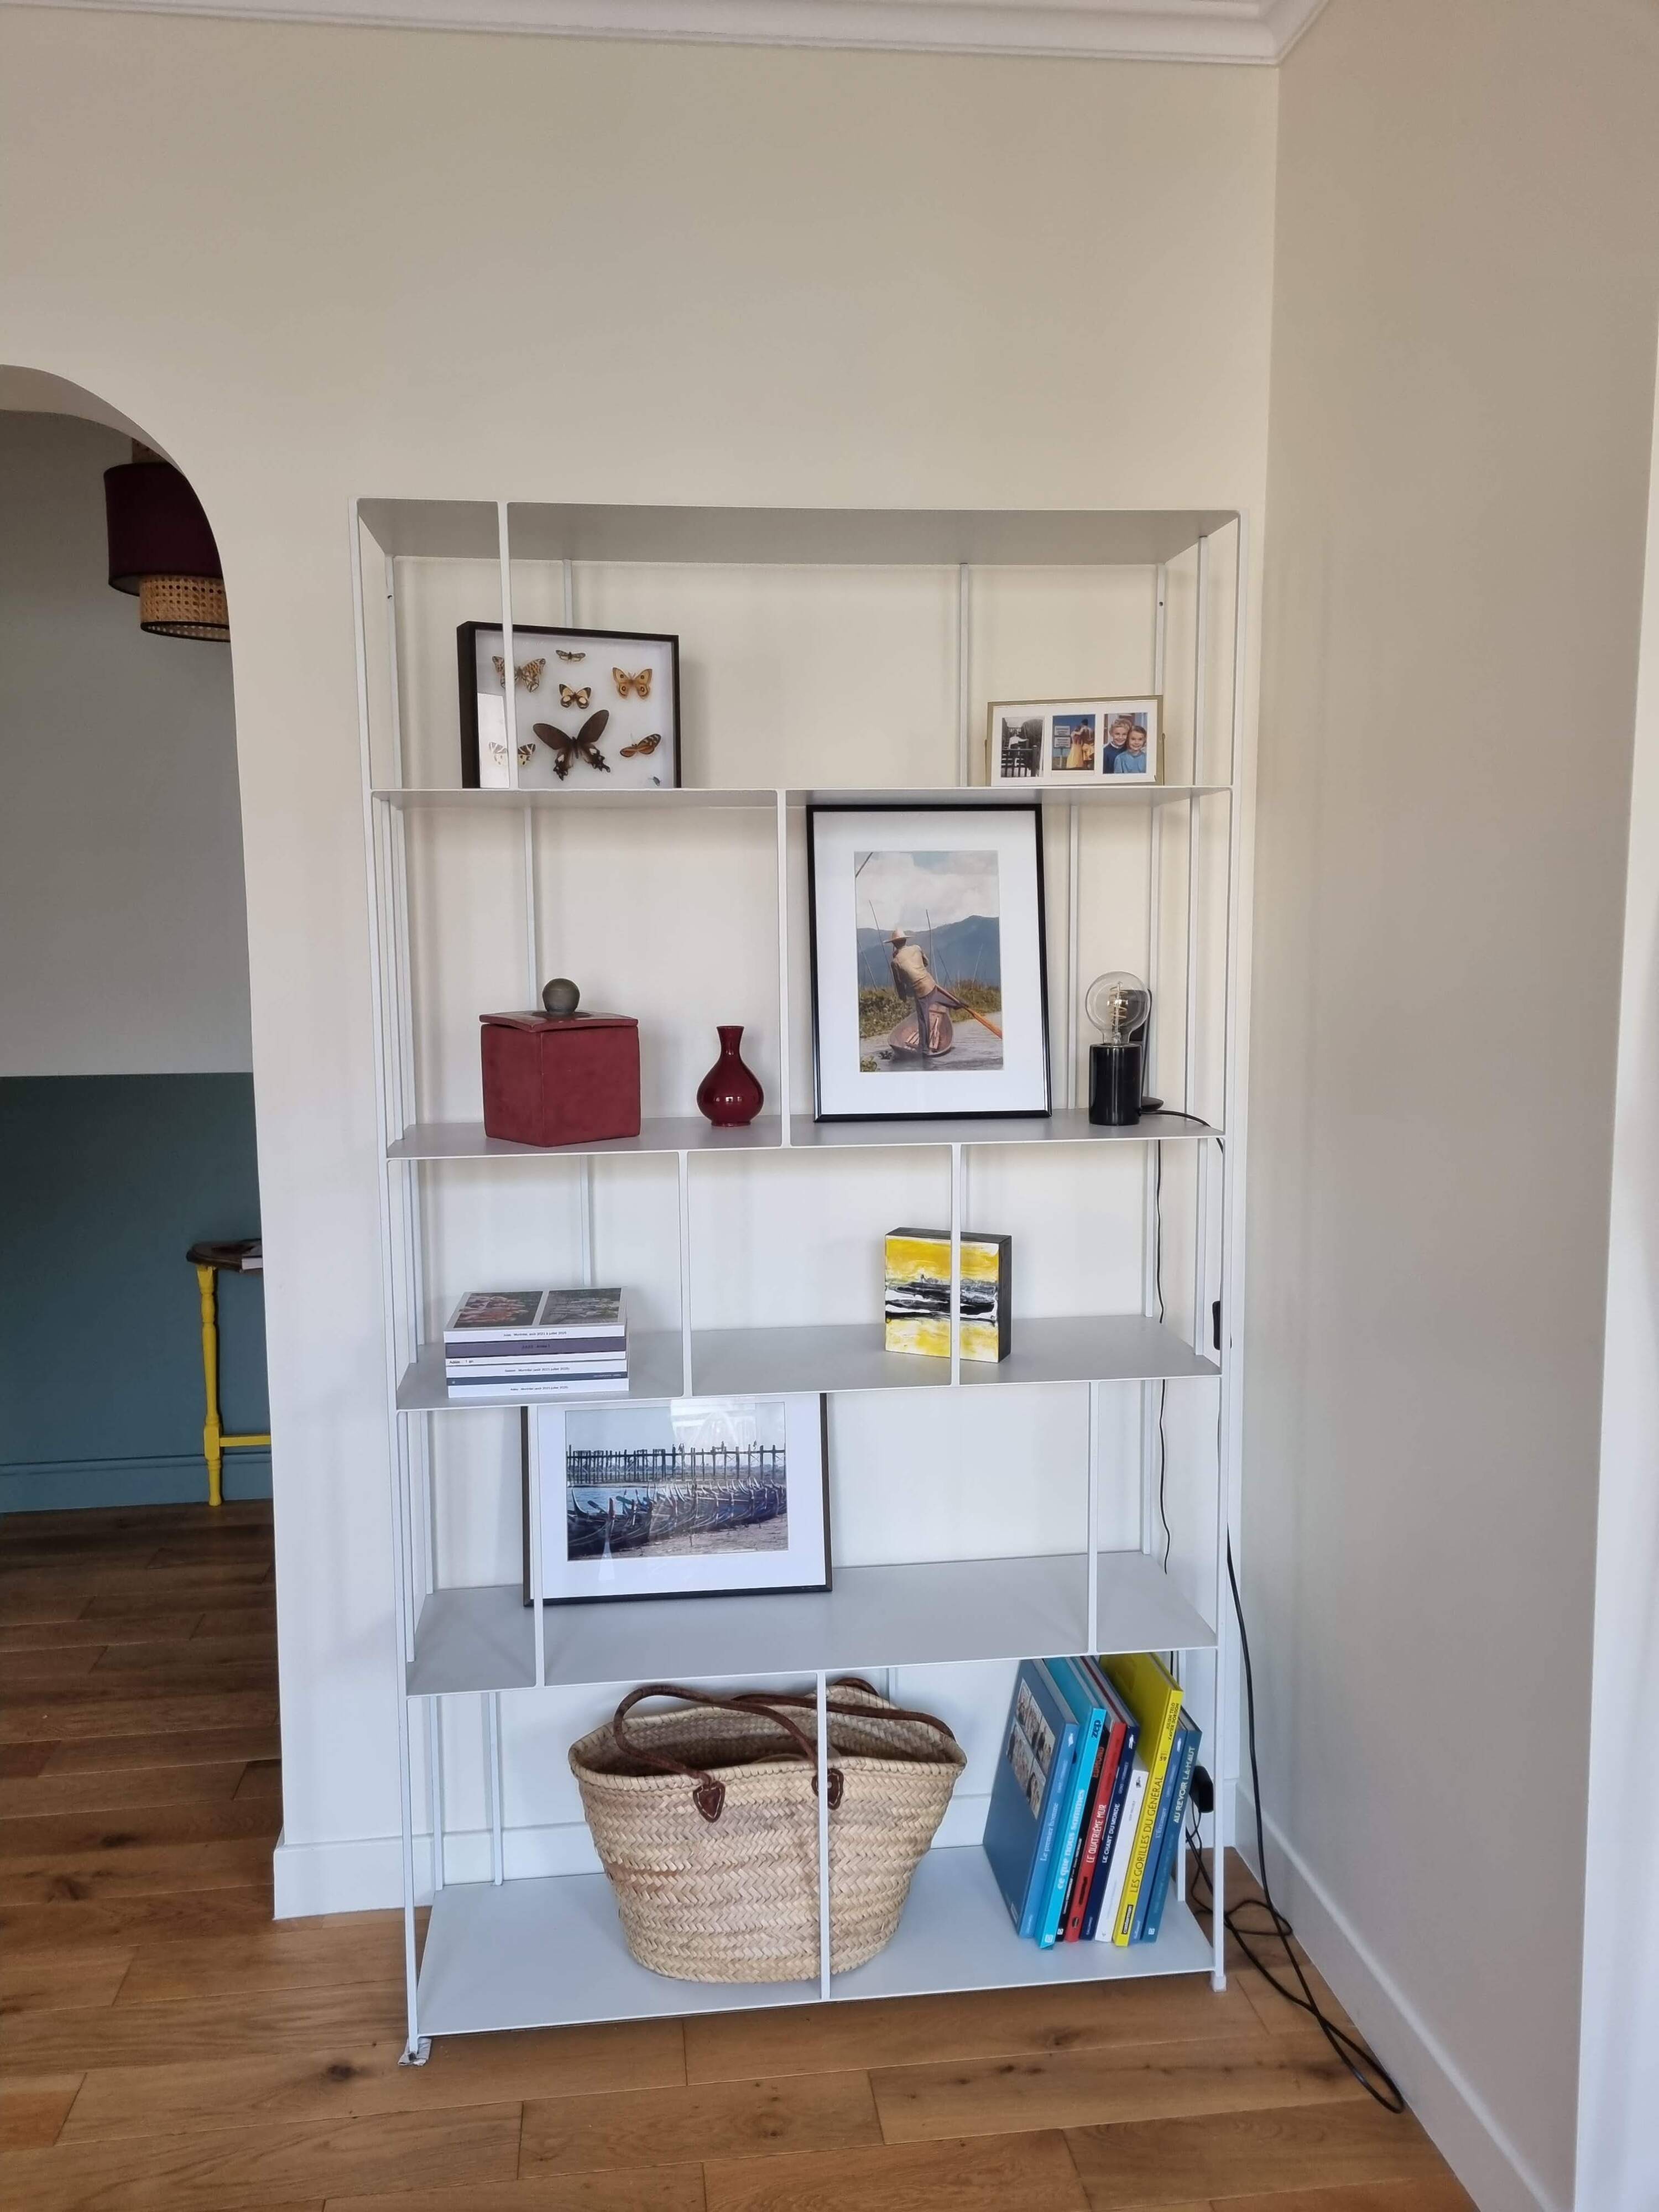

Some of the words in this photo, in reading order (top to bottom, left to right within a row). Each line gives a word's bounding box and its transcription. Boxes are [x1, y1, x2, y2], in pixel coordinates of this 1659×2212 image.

[1093, 1746, 1105, 1778] EDMOND
[1147, 1775, 1164, 1817] GÉNÉRAL
[1176, 1781, 1188, 1812] REVOIR
[1070, 1788, 1086, 1831] sommes
[1110, 1802, 1120, 1825] MONDE
[1173, 1812, 1181, 1824] AU
[1040, 1852, 1048, 1862] Le
[1044, 1827, 1054, 1853] premier
[1050, 1802, 1059, 1827] homme
[1086, 1854, 1095, 1864] LE
[1097, 1804, 1107, 1818] MUR
[1108, 1824, 1115, 1834] DU
[1143, 1818, 1154, 1833] DU
[1065, 1831, 1075, 1856] nous
[1103, 1834, 1113, 1855] CHANT
[1060, 1856, 1070, 1877] que
[1102, 1854, 1108, 1864] LE
[1134, 1835, 1150, 1877] GORILLES
[1057, 1877, 1066, 1890] ce
[1129, 1879, 1140, 1893] LES
